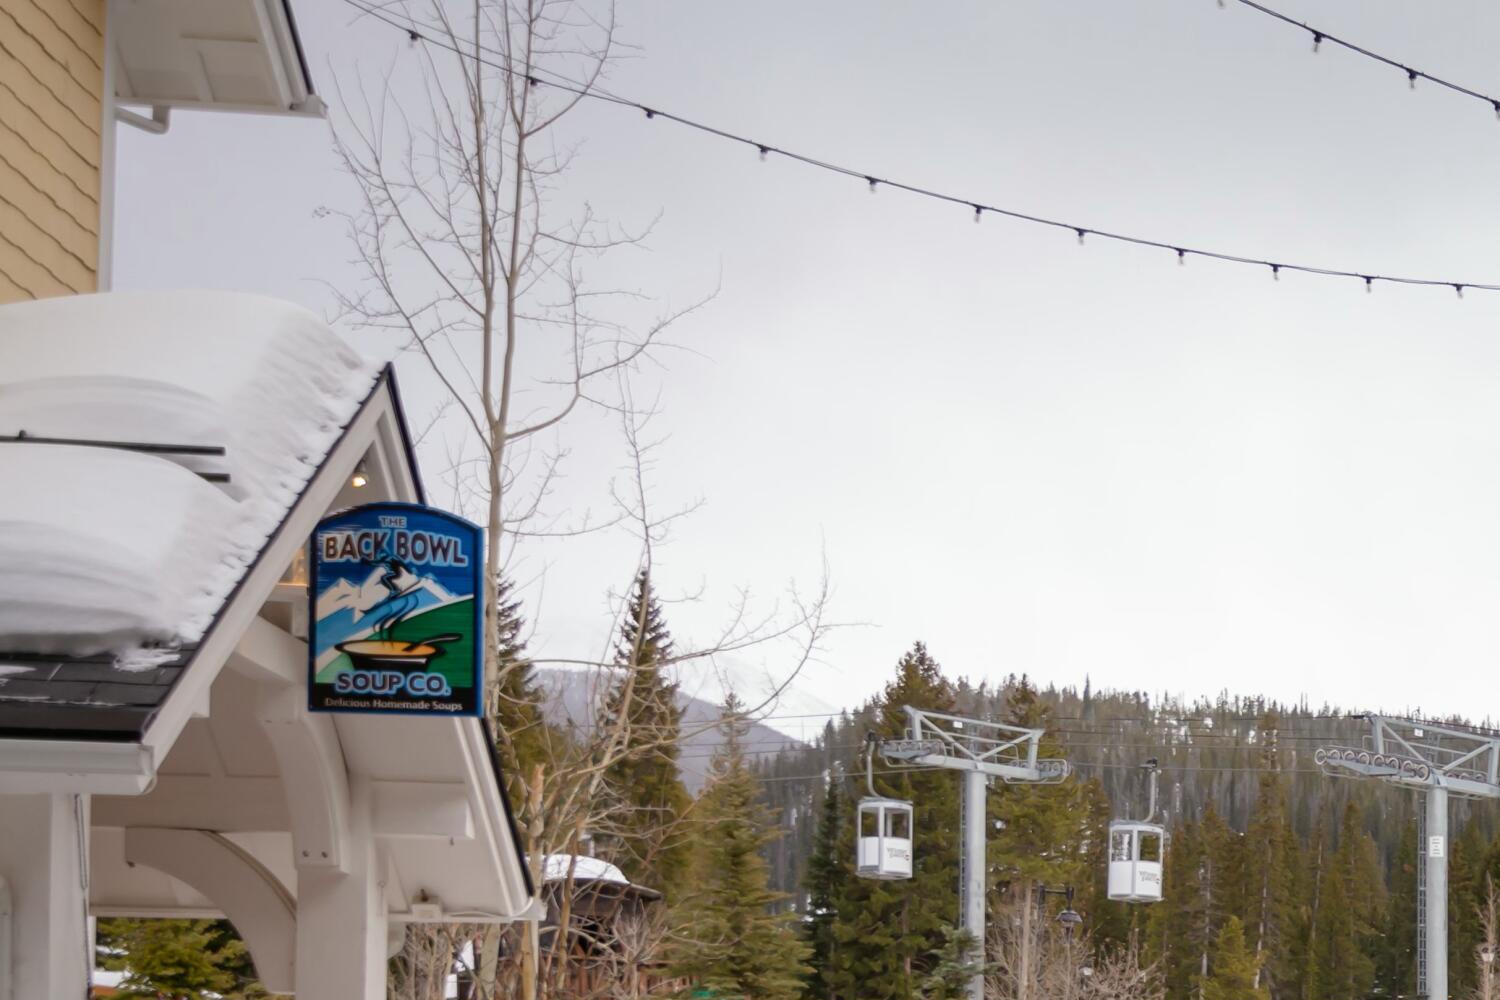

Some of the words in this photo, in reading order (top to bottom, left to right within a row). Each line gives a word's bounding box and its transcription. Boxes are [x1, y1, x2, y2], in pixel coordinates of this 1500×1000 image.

[379, 516, 407, 528] THE
[324, 530, 389, 562] BACK
[396, 531, 468, 566] BOWL
[335, 671, 403, 693] SOUP
[408, 672, 451, 695] CO.
[325, 697, 370, 708] Delicious
[373, 699, 430, 710] Homemade
[432, 701, 463, 712] Soups
